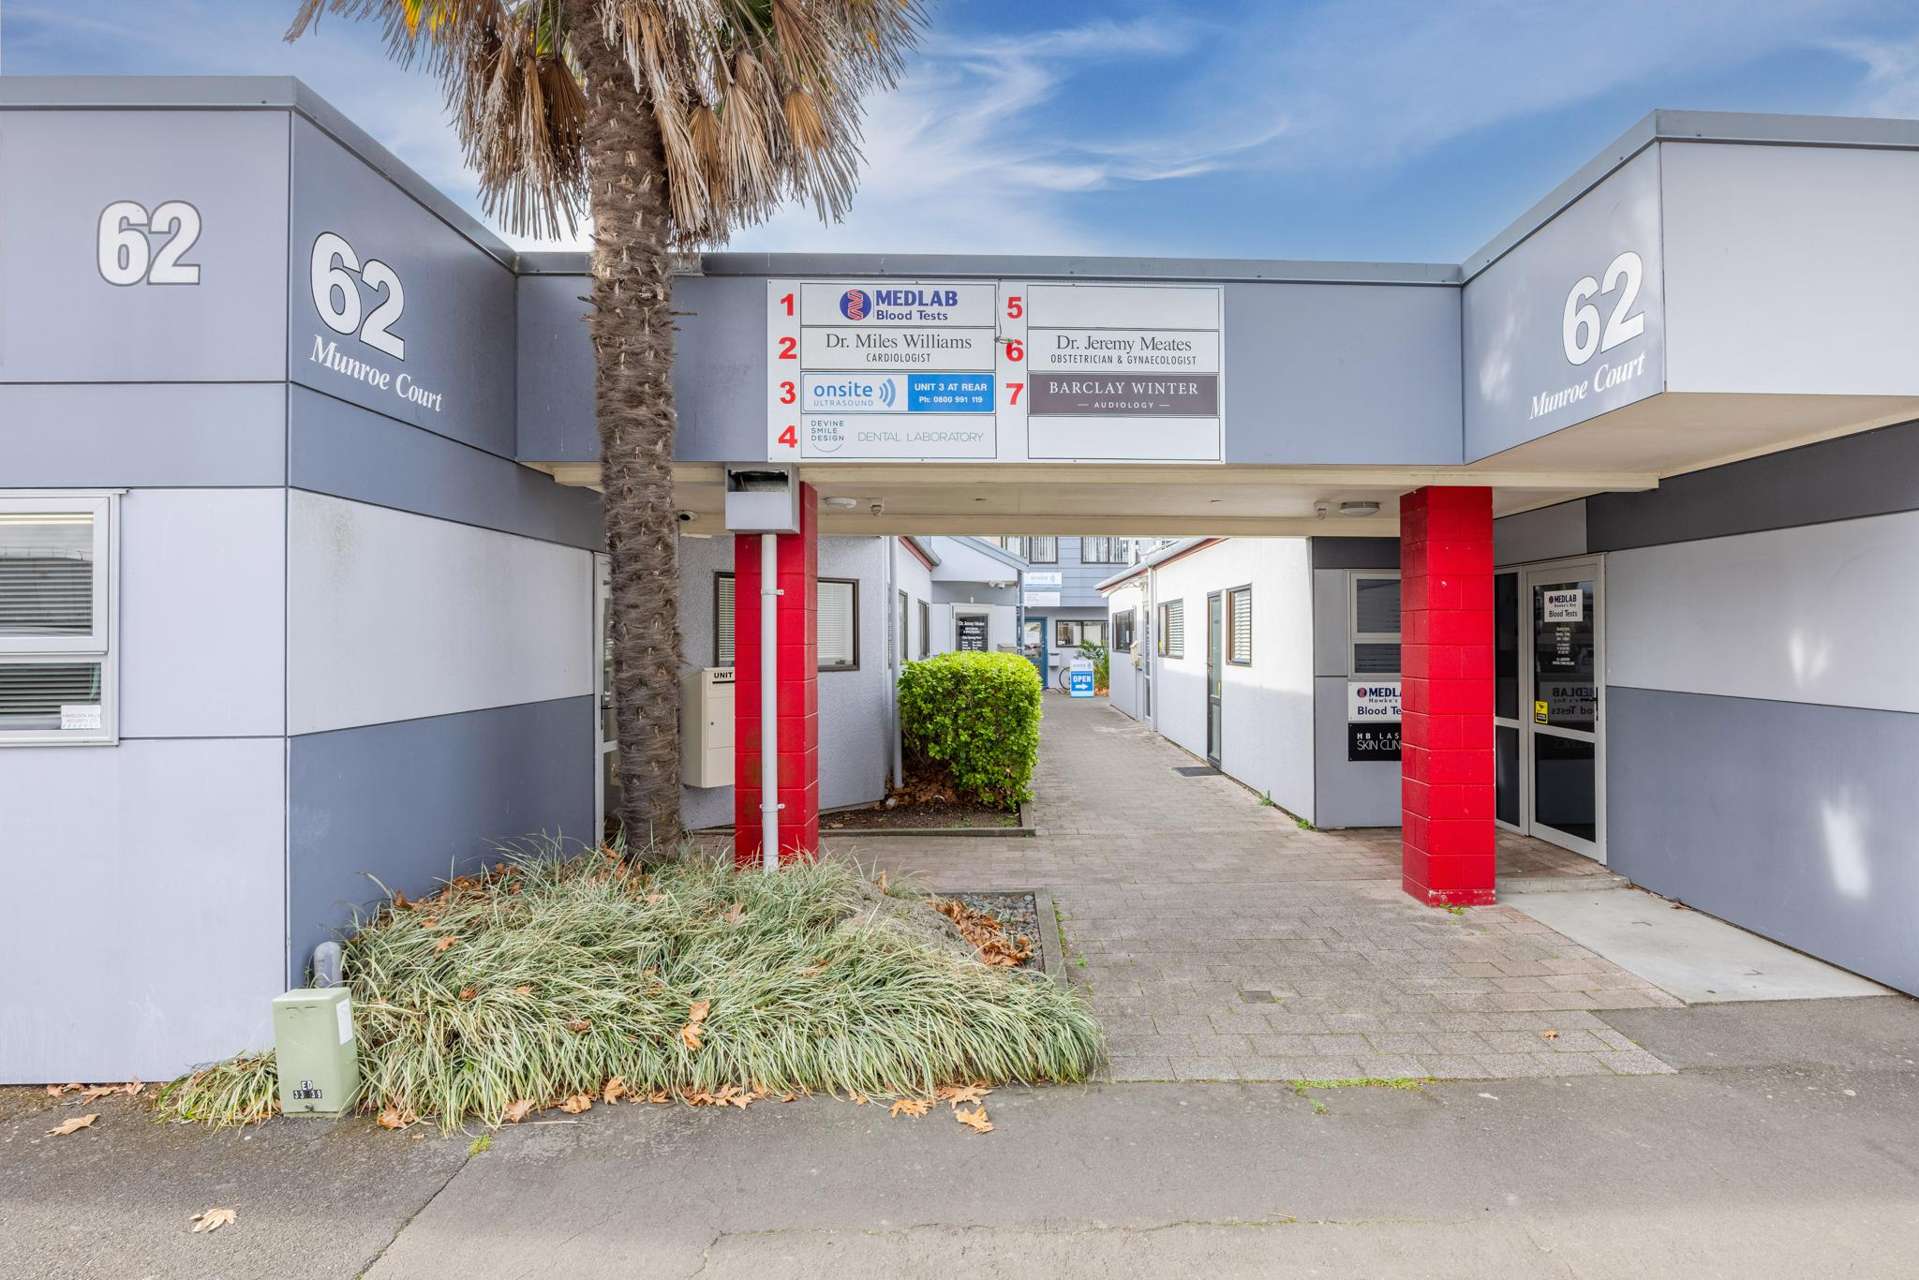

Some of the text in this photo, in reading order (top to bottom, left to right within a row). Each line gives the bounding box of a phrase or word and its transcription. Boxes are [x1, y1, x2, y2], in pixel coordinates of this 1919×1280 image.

[97, 200, 201, 286] 62
[310, 231, 405, 361] 62
[876, 290, 958, 307] MEDLAB
[780, 294, 794, 316] 1
[1007, 296, 1023, 319] 5
[1563, 251, 1645, 366] 62
[876, 309, 948, 321] Blood Tests
[778, 337, 797, 359] 2
[826, 333, 972, 349] Dr. Miles Williams
[1057, 335, 1192, 354] Dr. Jeremy Meates
[866, 353, 931, 363] CARDIOLOGIST
[1006, 339, 1024, 362] 6
[1050, 353, 1197, 365] OBSTETRICIAN & GYNAECOLOGIST
[310, 334, 442, 411] Munroe Court
[779, 381, 797, 404] 3
[814, 381, 873, 397] onsite
[914, 383, 988, 391] UNIT 3 AT REAR
[1049, 381, 1199, 395] BARCLAY WINTER
[1528, 351, 1646, 420] Munroe Court
[1005, 383, 1024, 405] 7
[1094, 401, 1154, 409] AUDIOLOGY
[778, 425, 798, 448] 4
[857, 432, 984, 442] DENTAL LABORATORY
[1554, 594, 1577, 603] MEDLAB
[1549, 610, 1564, 618] Blood
[1369, 688, 1402, 697] MEDL
[1357, 706, 1387, 715] Blood
[1357, 740, 1378, 750] SKIN
